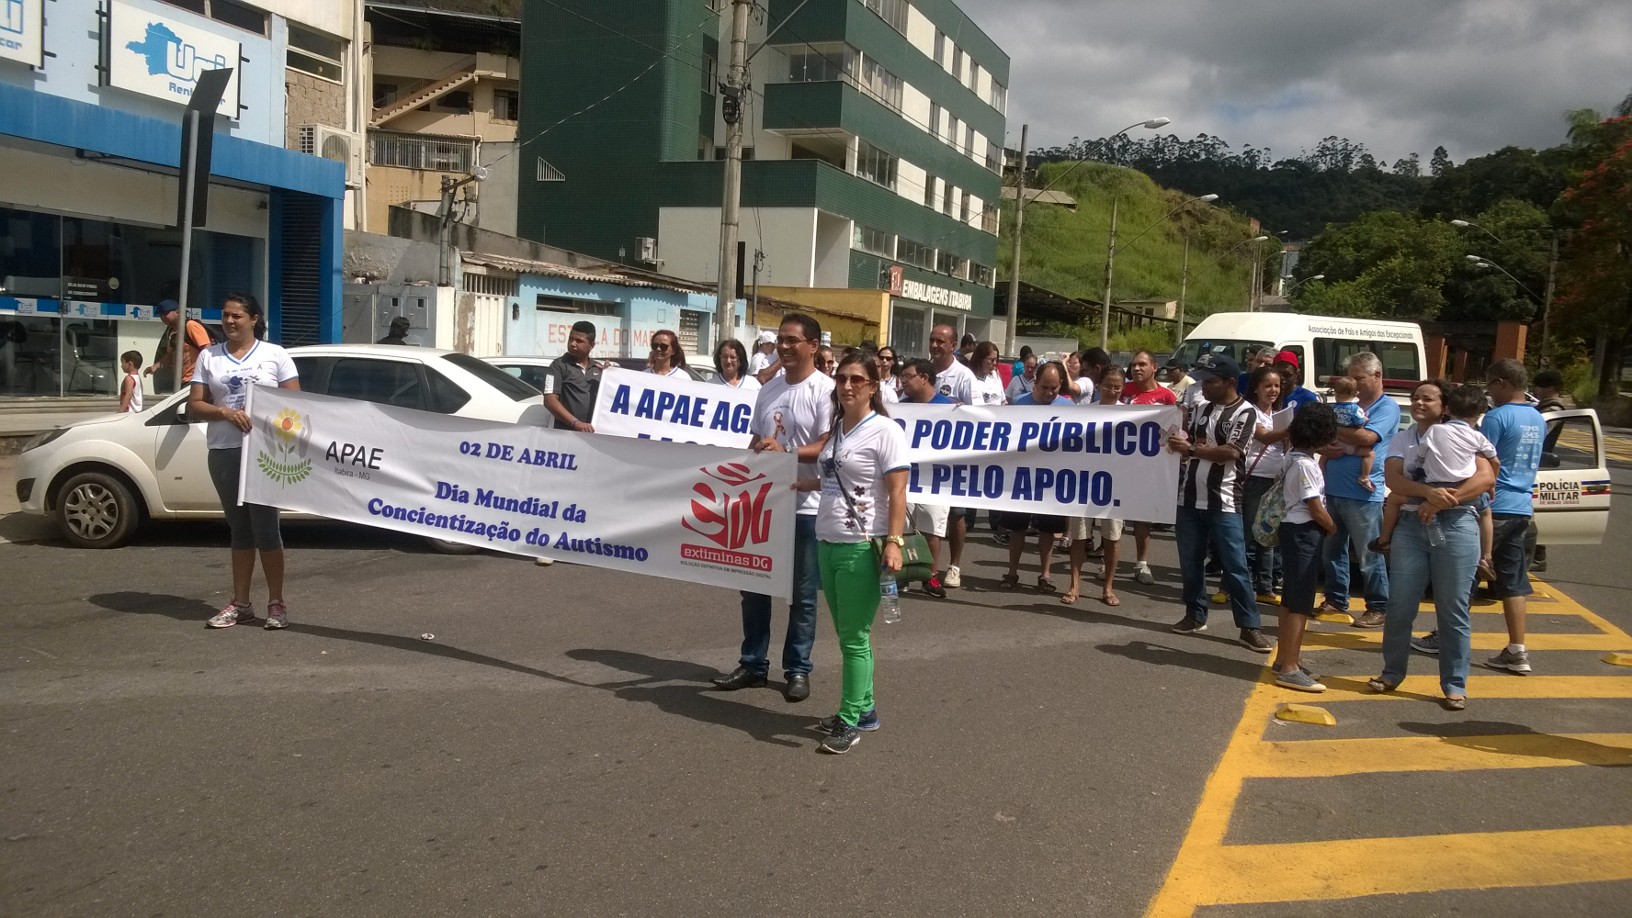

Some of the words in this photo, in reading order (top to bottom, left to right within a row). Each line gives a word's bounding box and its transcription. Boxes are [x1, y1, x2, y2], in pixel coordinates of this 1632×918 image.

[902, 279, 949, 306] EMBALAGENS
[948, 290, 972, 311] ITABIRA
[1308, 324, 1337, 336] Associação
[1338, 326, 1345, 335] de
[1345, 327, 1355, 336] Pais
[1360, 328, 1376, 338] Amigos
[1386, 330, 1414, 340] Excepcionais
[610, 384, 631, 416] A
[634, 388, 708, 428] APAE
[709, 400, 754, 435] AG
[911, 419, 1011, 451] PODER
[1017, 416, 1161, 457] PÚBLICO
[326, 441, 384, 470] APAE
[459, 441, 482, 457] 02
[485, 442, 515, 462] DE
[517, 448, 578, 471] ABRIL
[334, 466, 354, 478] Itabira
[358, 471, 371, 481] MG
[931, 464, 1004, 499] PELO
[1011, 466, 1121, 507] APOIO.
[1540, 478, 1580, 490] POLÍCIA
[435, 481, 470, 504] Dia
[474, 488, 559, 519] Mundial
[562, 503, 587, 523] da
[1540, 492, 1579, 501] MILITAR
[368, 497, 521, 541] Concientização
[525, 527, 550, 547] do
[553, 531, 649, 562] Autismo
[684, 548, 750, 567] extiminas
[752, 556, 769, 569] DG
